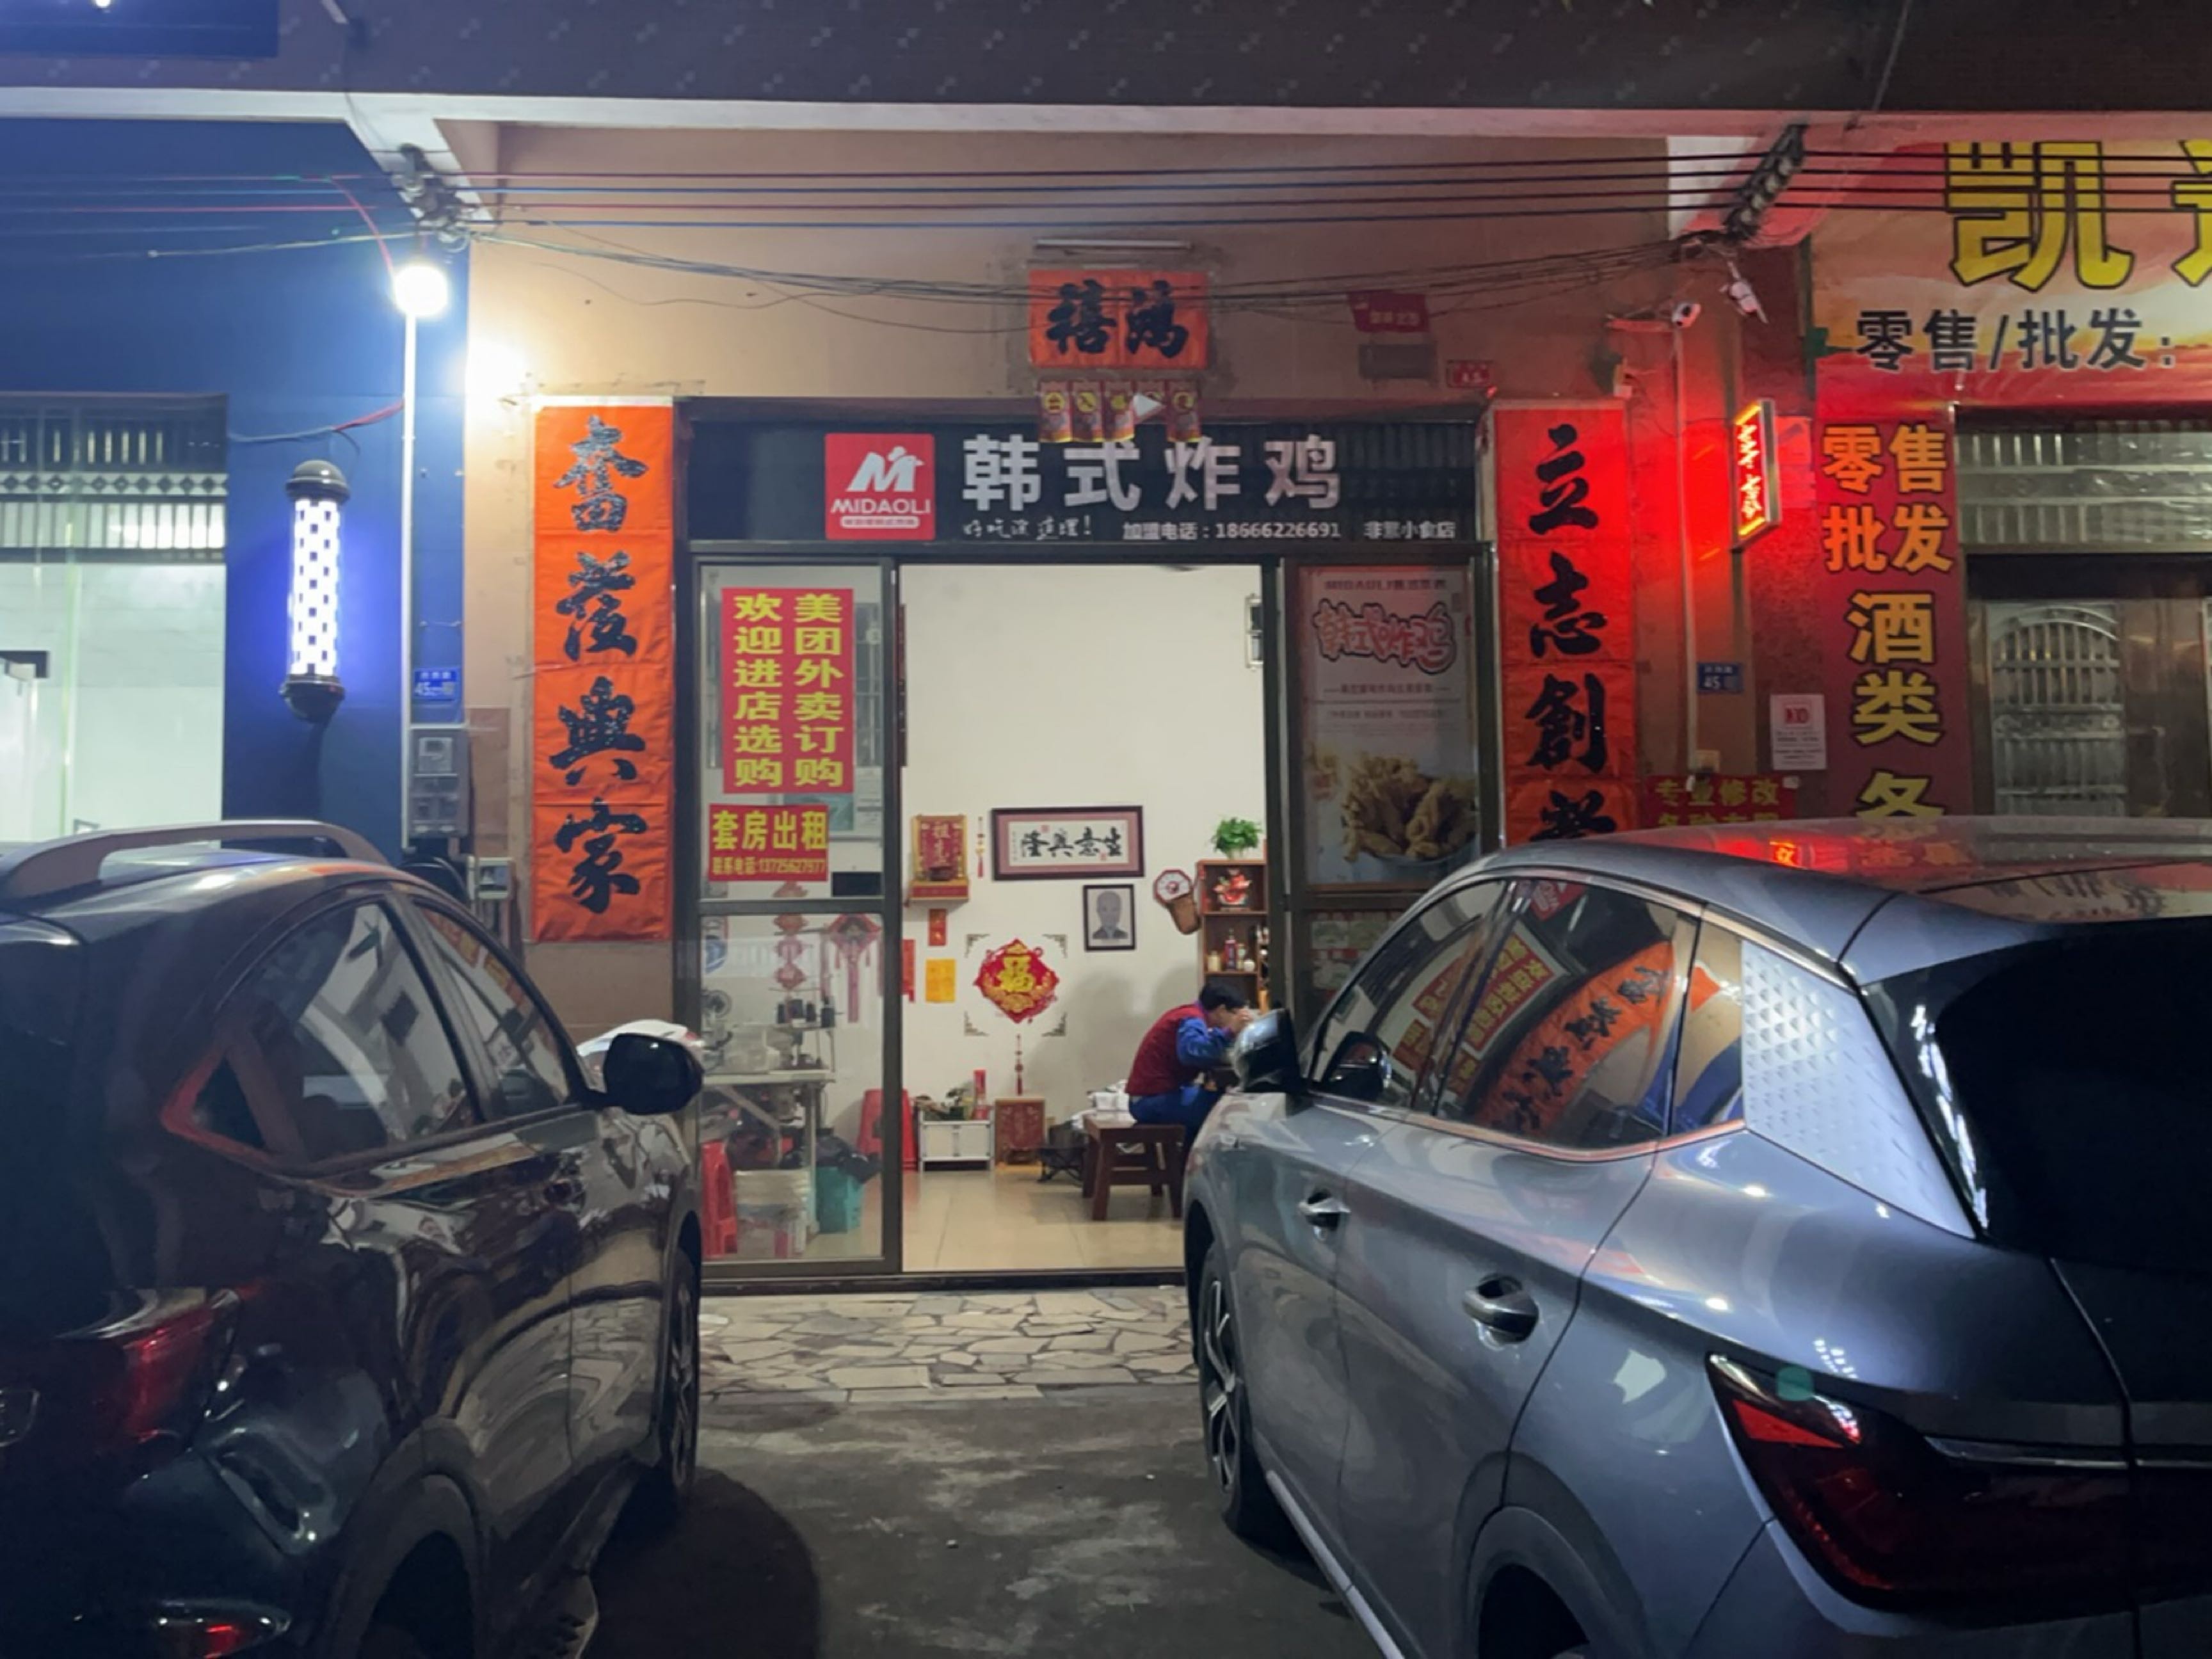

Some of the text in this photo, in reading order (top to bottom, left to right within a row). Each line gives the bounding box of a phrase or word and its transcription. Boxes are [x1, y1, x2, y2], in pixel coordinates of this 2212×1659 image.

[962, 433, 1340, 511] 韩式炸鸡
[1821, 422, 1947, 495] 零售
[831, 499, 931, 514] MIDAOLI
[1822, 504, 1953, 574] 批发
[733, 593, 783, 788] 欢迎进店选购
[794, 593, 844, 788] 美团外卖订购
[712, 809, 828, 851] 套房出租
